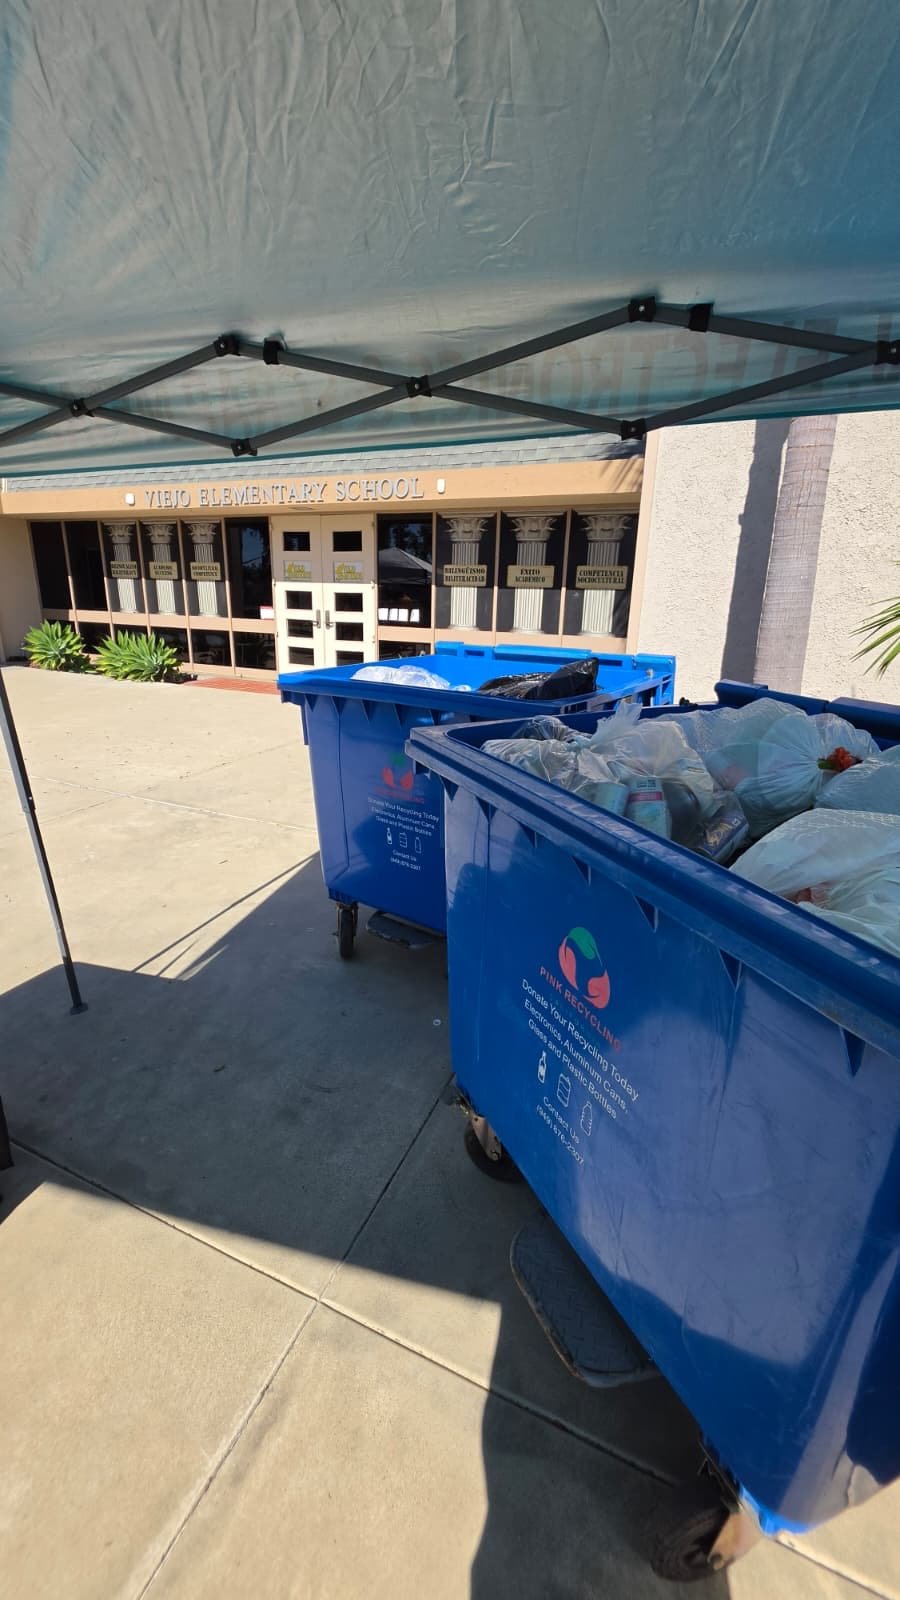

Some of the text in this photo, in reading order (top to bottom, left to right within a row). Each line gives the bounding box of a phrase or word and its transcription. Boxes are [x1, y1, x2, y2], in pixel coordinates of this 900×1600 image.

[144, 477, 425, 508] VIEJO ELEMENTARY SCHOOL
[522, 978, 549, 1009] Donate
[549, 1003, 568, 1027] Your
[568, 1021, 609, 1072] Recycling
[610, 1063, 639, 1102] Today
[540, 966, 563, 993] PINK
[564, 989, 622, 1052] RECYCLING
[525, 998, 563, 1045] Electronics,
[563, 1039, 602, 1084] Aluminum
[603, 1080, 628, 1114] Cans,
[529, 1018, 617, 1119] Glass and Plastic Bottles
[543, 1096, 580, 1144] Contact Us
